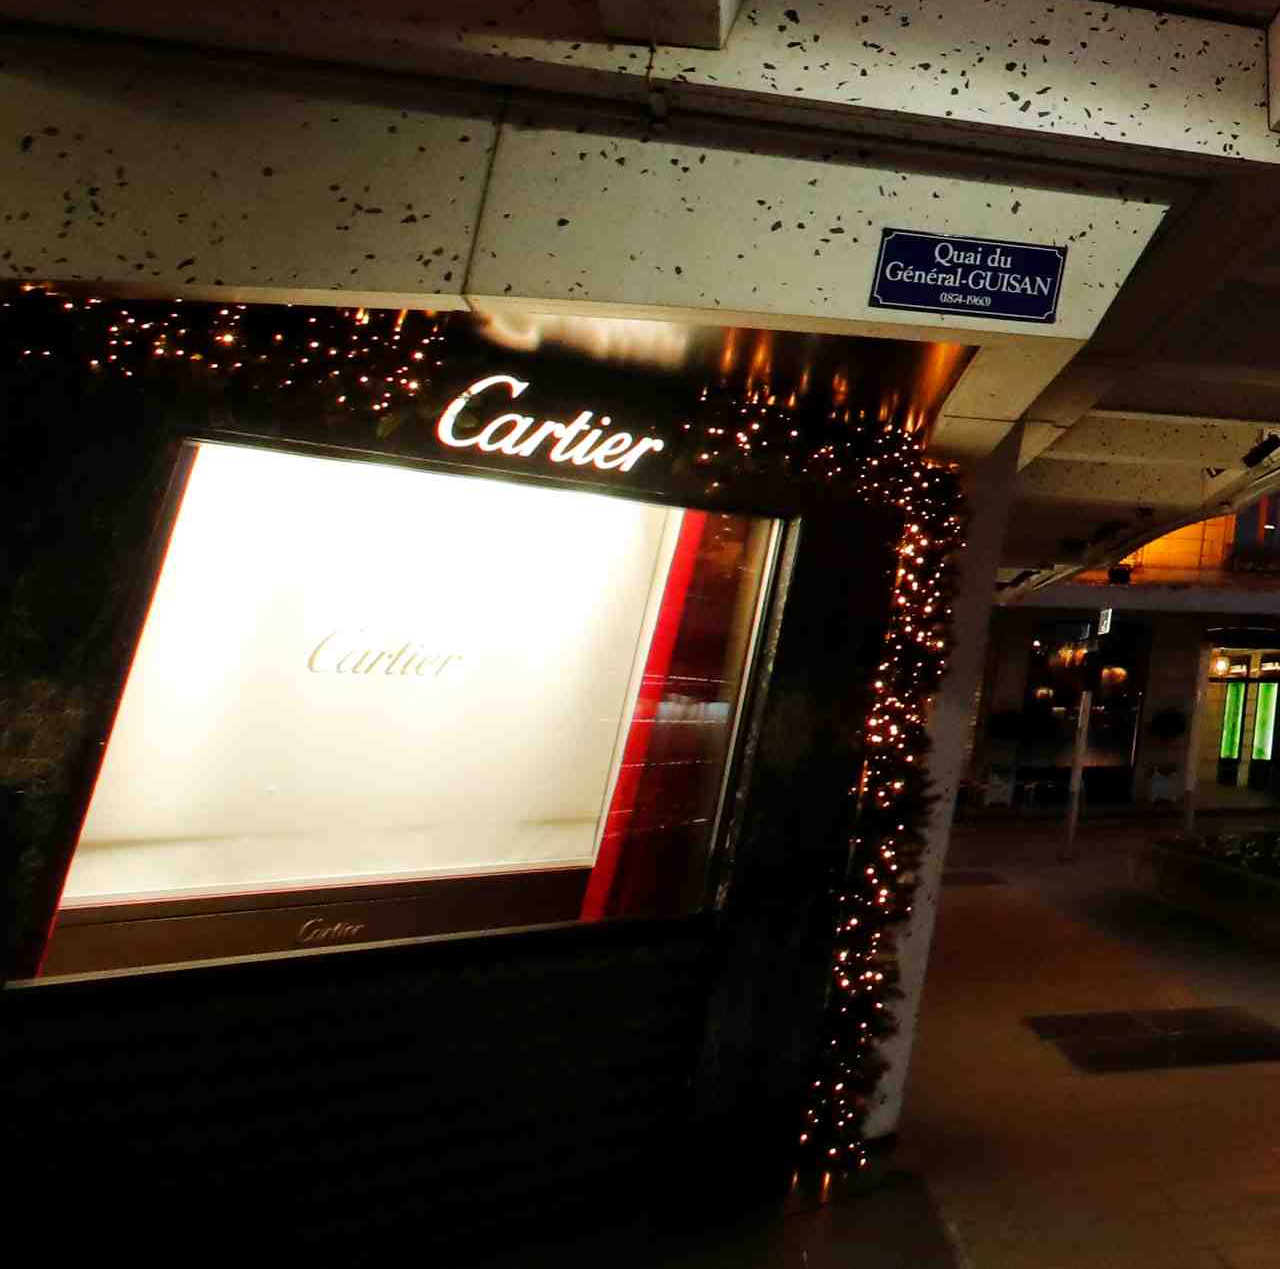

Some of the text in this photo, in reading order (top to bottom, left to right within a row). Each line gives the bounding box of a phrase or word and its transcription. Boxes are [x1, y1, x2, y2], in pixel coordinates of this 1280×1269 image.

[934, 241, 1013, 268] Quai du
[885, 261, 1052, 296] Général-GUISAN
[437, 374, 665, 472] Cartier
[306, 628, 464, 678] Cartier
[298, 917, 365, 943] Cartier
